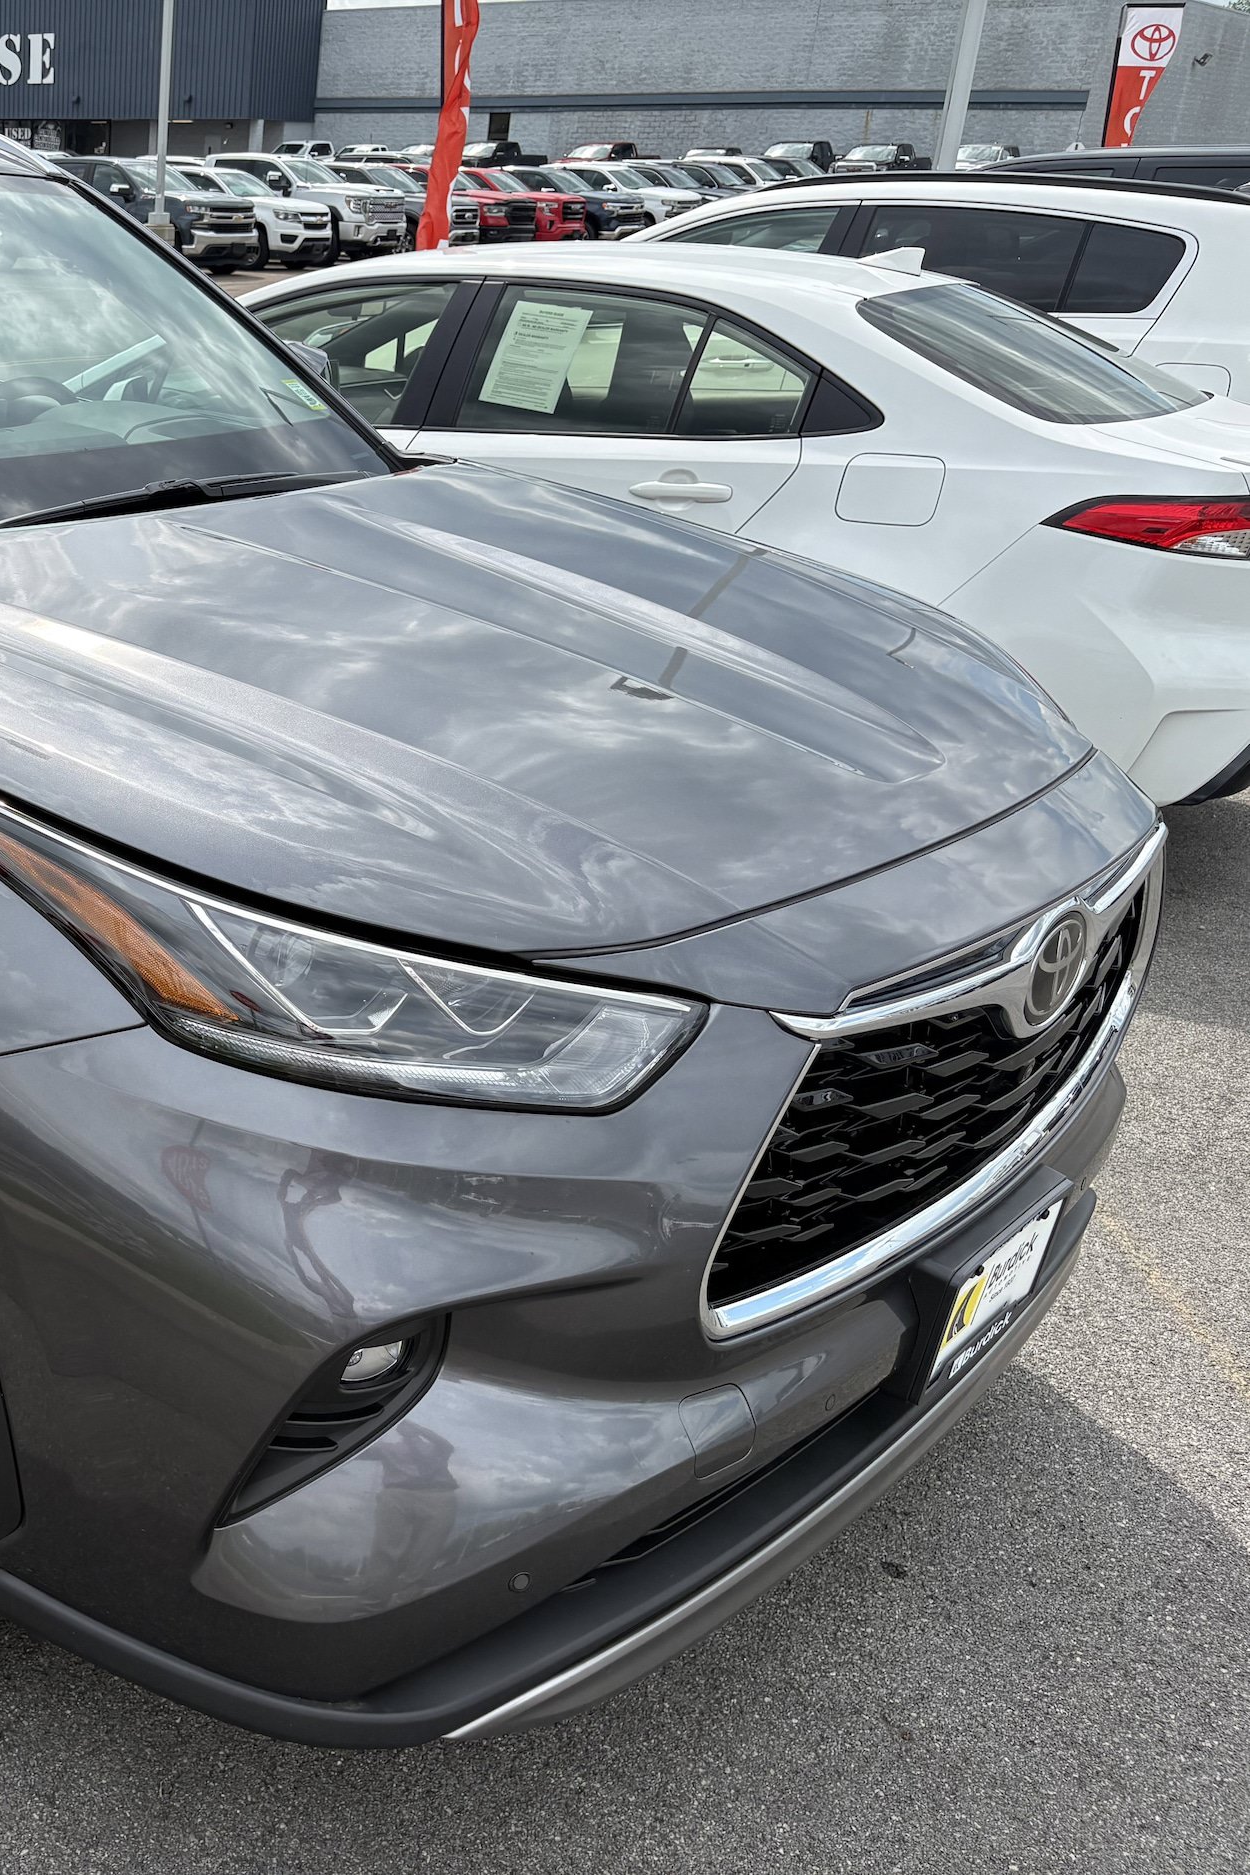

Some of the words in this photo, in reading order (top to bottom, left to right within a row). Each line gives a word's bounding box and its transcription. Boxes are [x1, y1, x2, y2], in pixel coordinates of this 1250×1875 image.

[4, 127, 32, 140] USED
[987, 1231, 1040, 1289] Burdick
[961, 1311, 1013, 1367] Burdick
